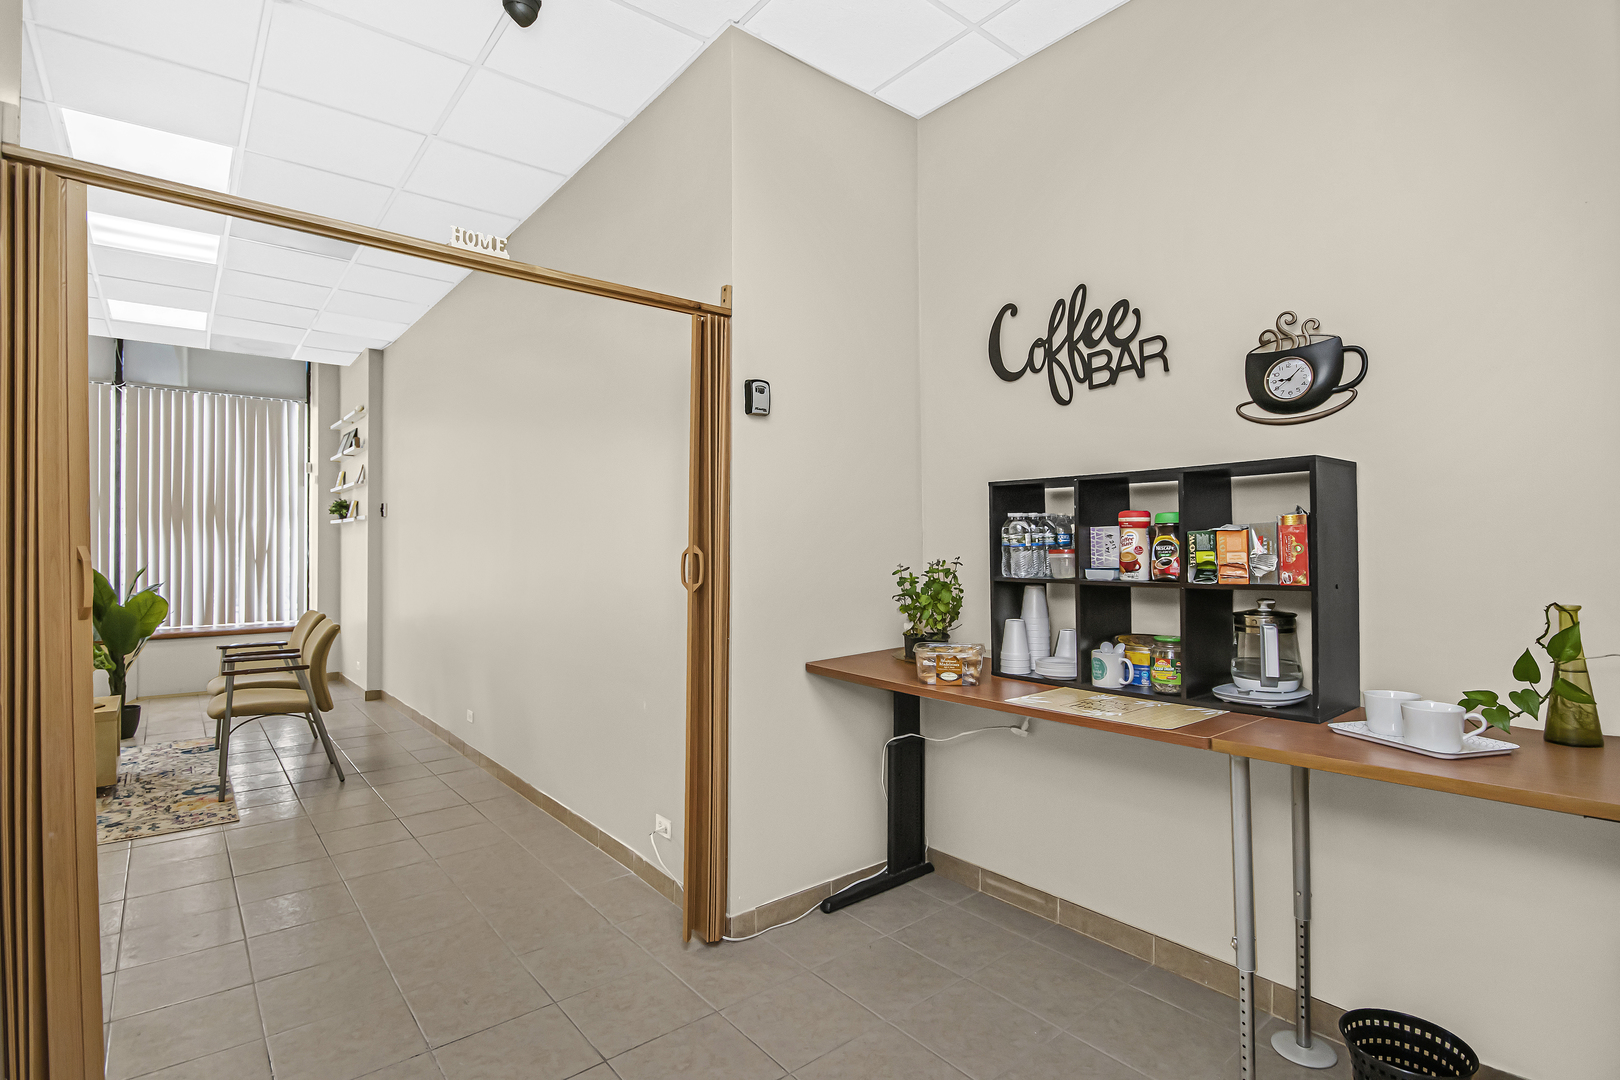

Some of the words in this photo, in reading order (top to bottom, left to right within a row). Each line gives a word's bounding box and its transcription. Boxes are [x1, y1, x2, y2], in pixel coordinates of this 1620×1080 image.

[450, 225, 508, 257] HOME
[988, 283, 1141, 406] Coffee
[1087, 335, 1170, 390] BAR
